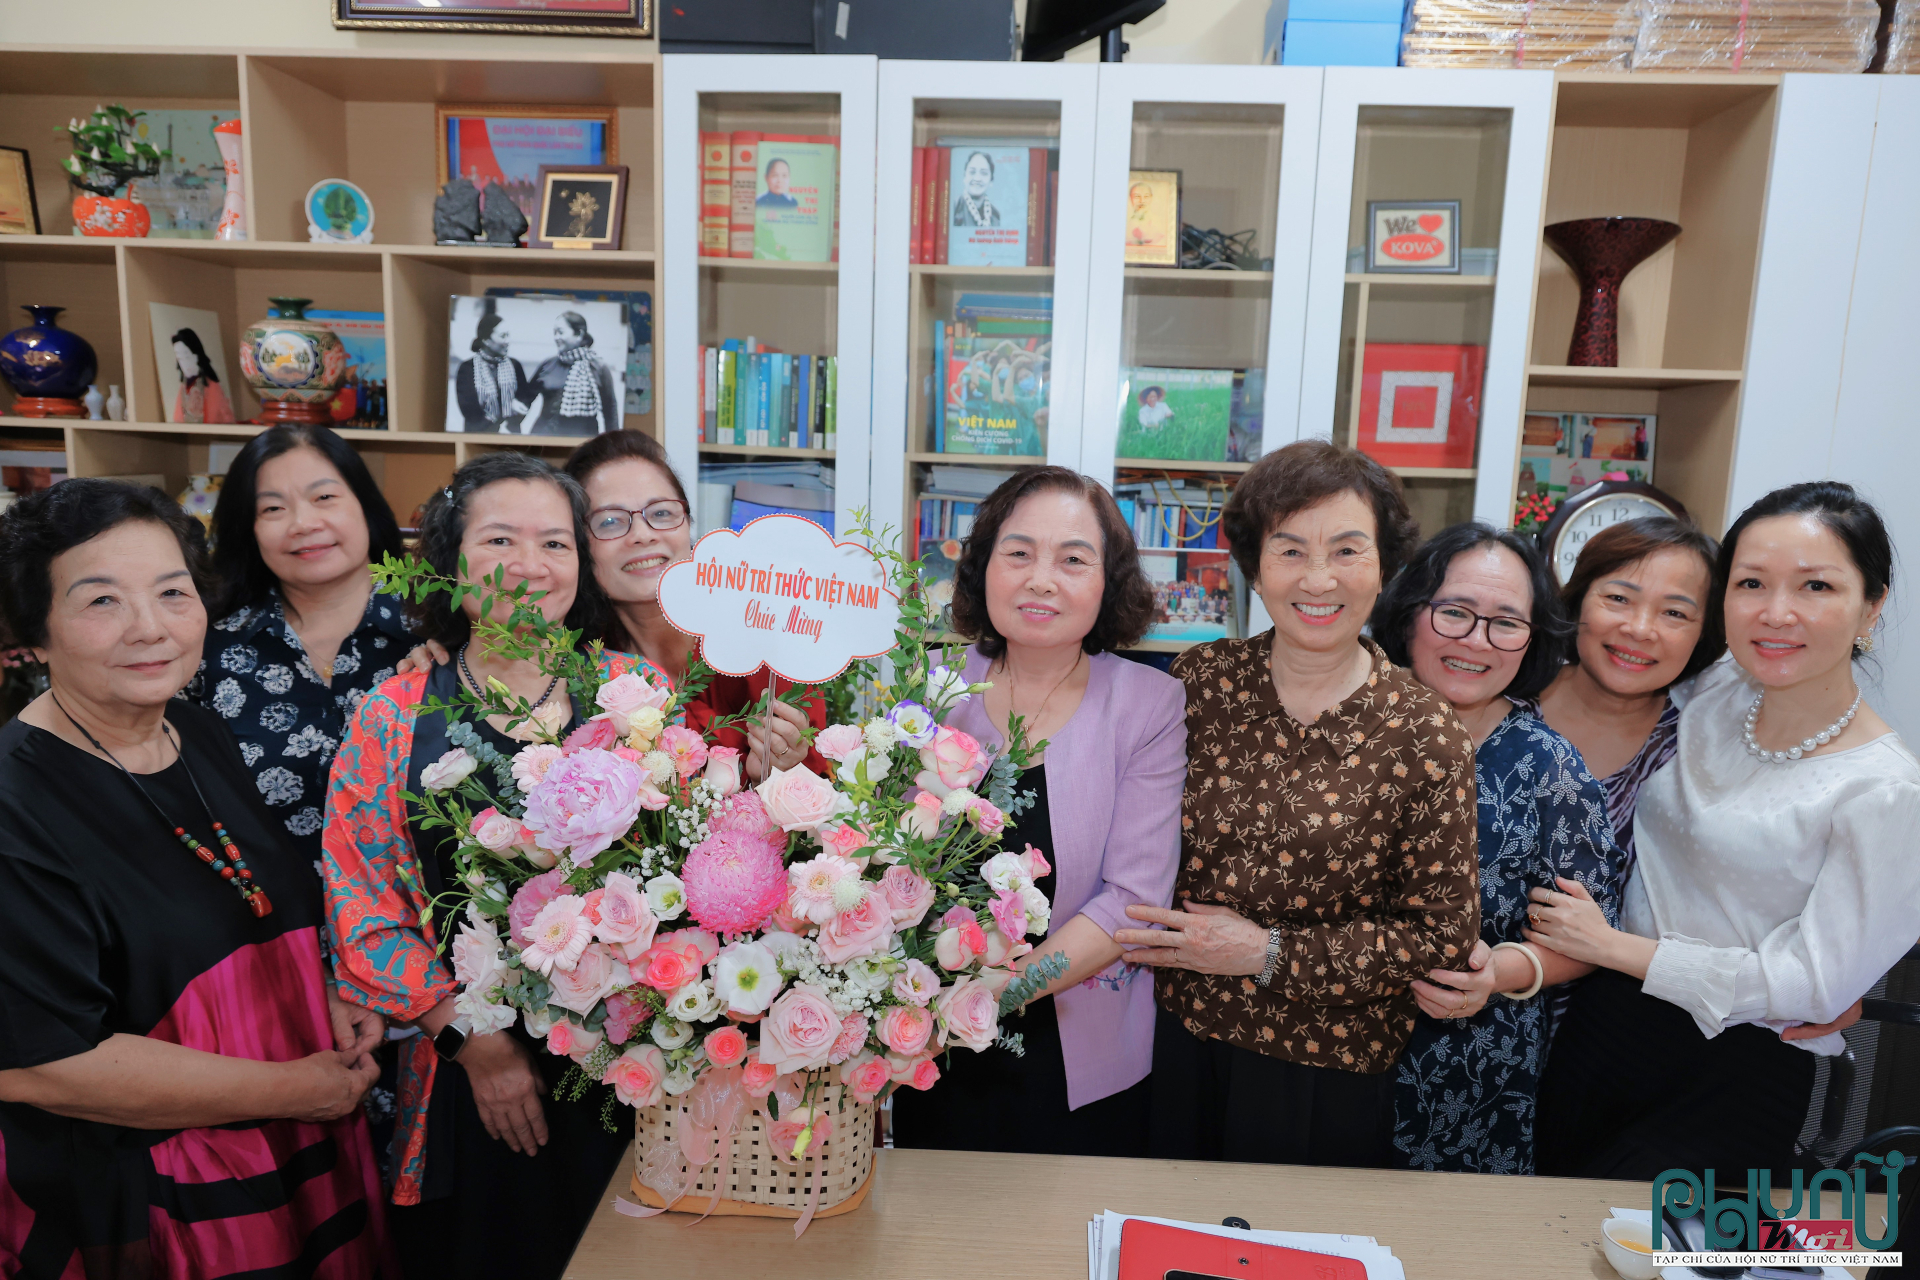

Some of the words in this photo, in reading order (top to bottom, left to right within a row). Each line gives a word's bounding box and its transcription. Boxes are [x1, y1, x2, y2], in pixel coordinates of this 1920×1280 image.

[1383, 215, 1417, 236] We
[958, 414, 984, 429] VIỆT
[986, 418, 1017, 429] NAM
[1590, 514, 1604, 527] 11
[1611, 508, 1629, 521] 12
[1572, 531, 1588, 543] 10
[1564, 552, 1574, 566] 9
[696, 556, 723, 594] HỘI
[726, 560, 749, 592] NỮ
[750, 564, 774, 594] TRÍ
[775, 568, 811, 600] THỨC
[815, 572, 845, 610] VIỆT
[846, 582, 880, 610] NAM
[744, 598, 776, 631] Chúc
[782, 604, 824, 644] Mừng
